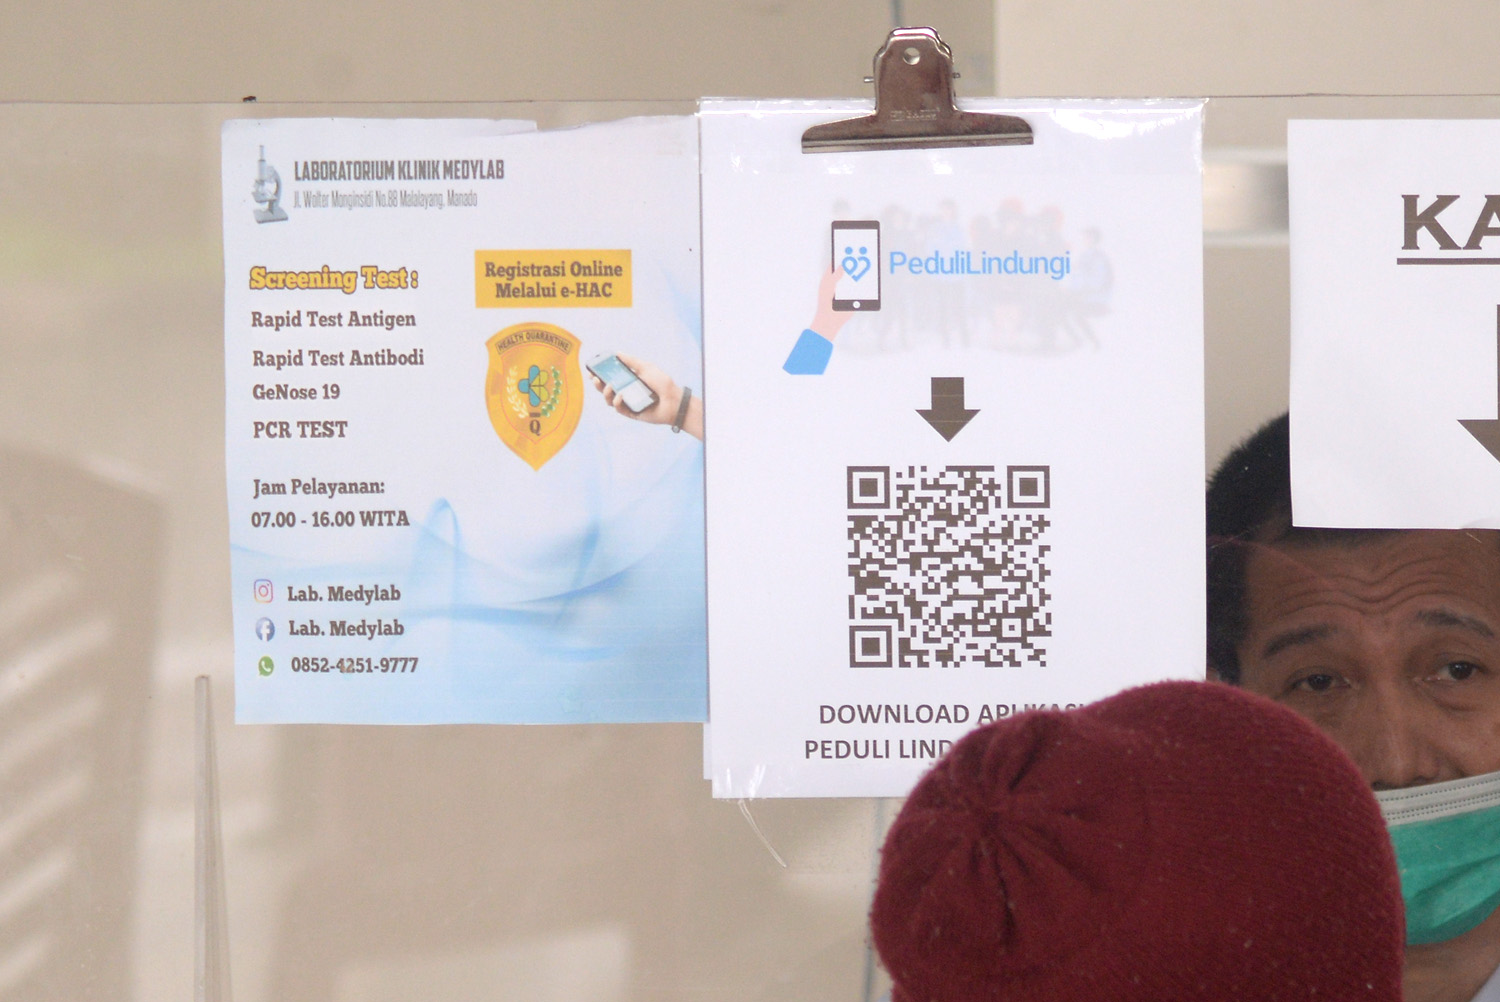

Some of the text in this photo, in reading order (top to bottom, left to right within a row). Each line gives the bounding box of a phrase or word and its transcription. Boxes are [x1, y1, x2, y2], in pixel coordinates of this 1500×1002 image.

[294, 159, 505, 182] LABORATORIUM KLINIK MEDYLAB
[447, 188, 478, 208] Manado
[484, 259, 623, 282] Registrasi Online
[889, 249, 1071, 281] PeduliLindungi
[249, 265, 357, 294] Screening
[361, 265, 409, 290] Test
[495, 281, 613, 299] Melalui e-HAC
[251, 309, 417, 332] Rapid Test Antigen
[252, 348, 425, 371] Rapid Test Antibodi
[252, 383, 341, 401] GeNose 19
[253, 420, 349, 439] PCR TEST
[529, 419, 541, 437] Q
[252, 477, 385, 500] Jam Pelayanan:
[250, 511, 297, 528] 07.00
[311, 510, 356, 528] 16.00
[358, 509, 411, 527] WITA
[287, 584, 401, 605] Lab. Medylab
[288, 619, 405, 640] Lab. Medylab
[290, 656, 419, 674] 0852-4251-9777
[819, 704, 970, 725] DOWNLOAD
[805, 739, 890, 760] PEDULI
